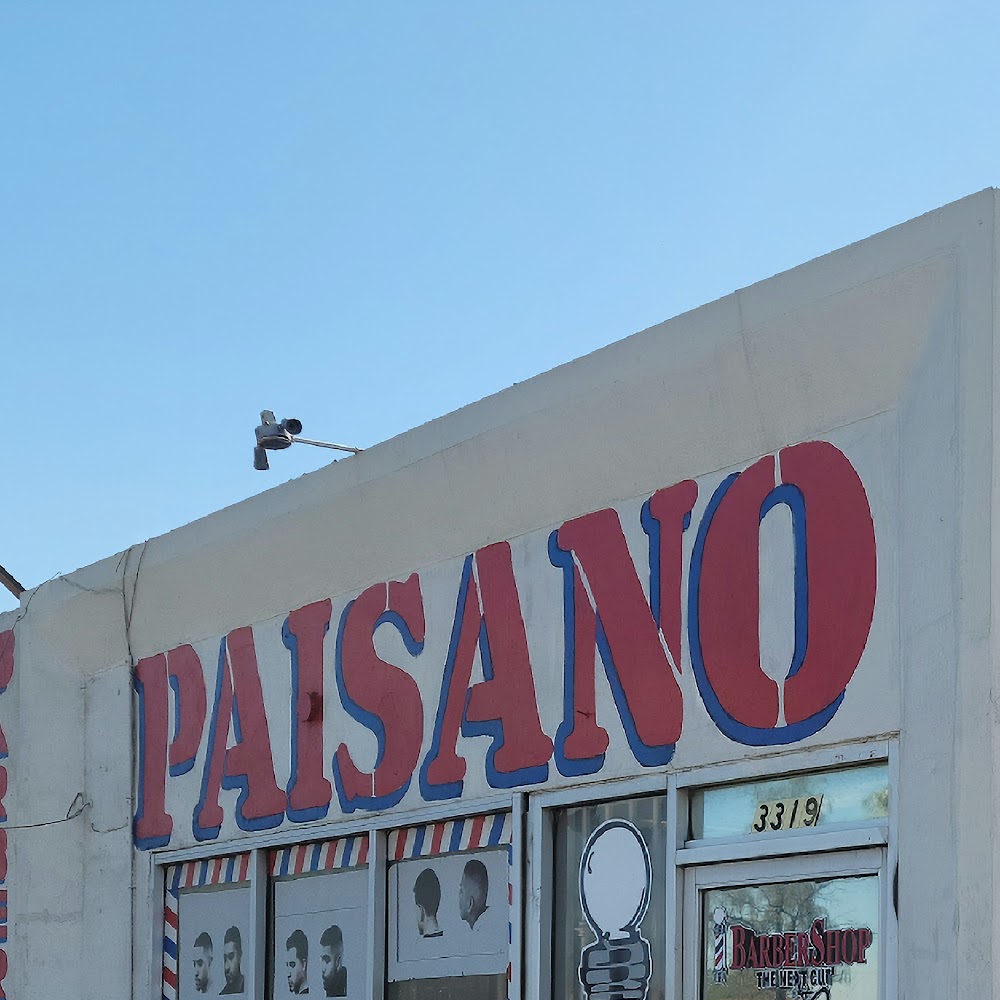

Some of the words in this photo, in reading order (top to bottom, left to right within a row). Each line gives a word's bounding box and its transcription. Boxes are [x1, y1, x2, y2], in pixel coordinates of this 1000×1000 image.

[134, 440, 878, 850] PAISANO
[753, 796, 819, 832] 3319
[756, 970, 777, 990] THE
